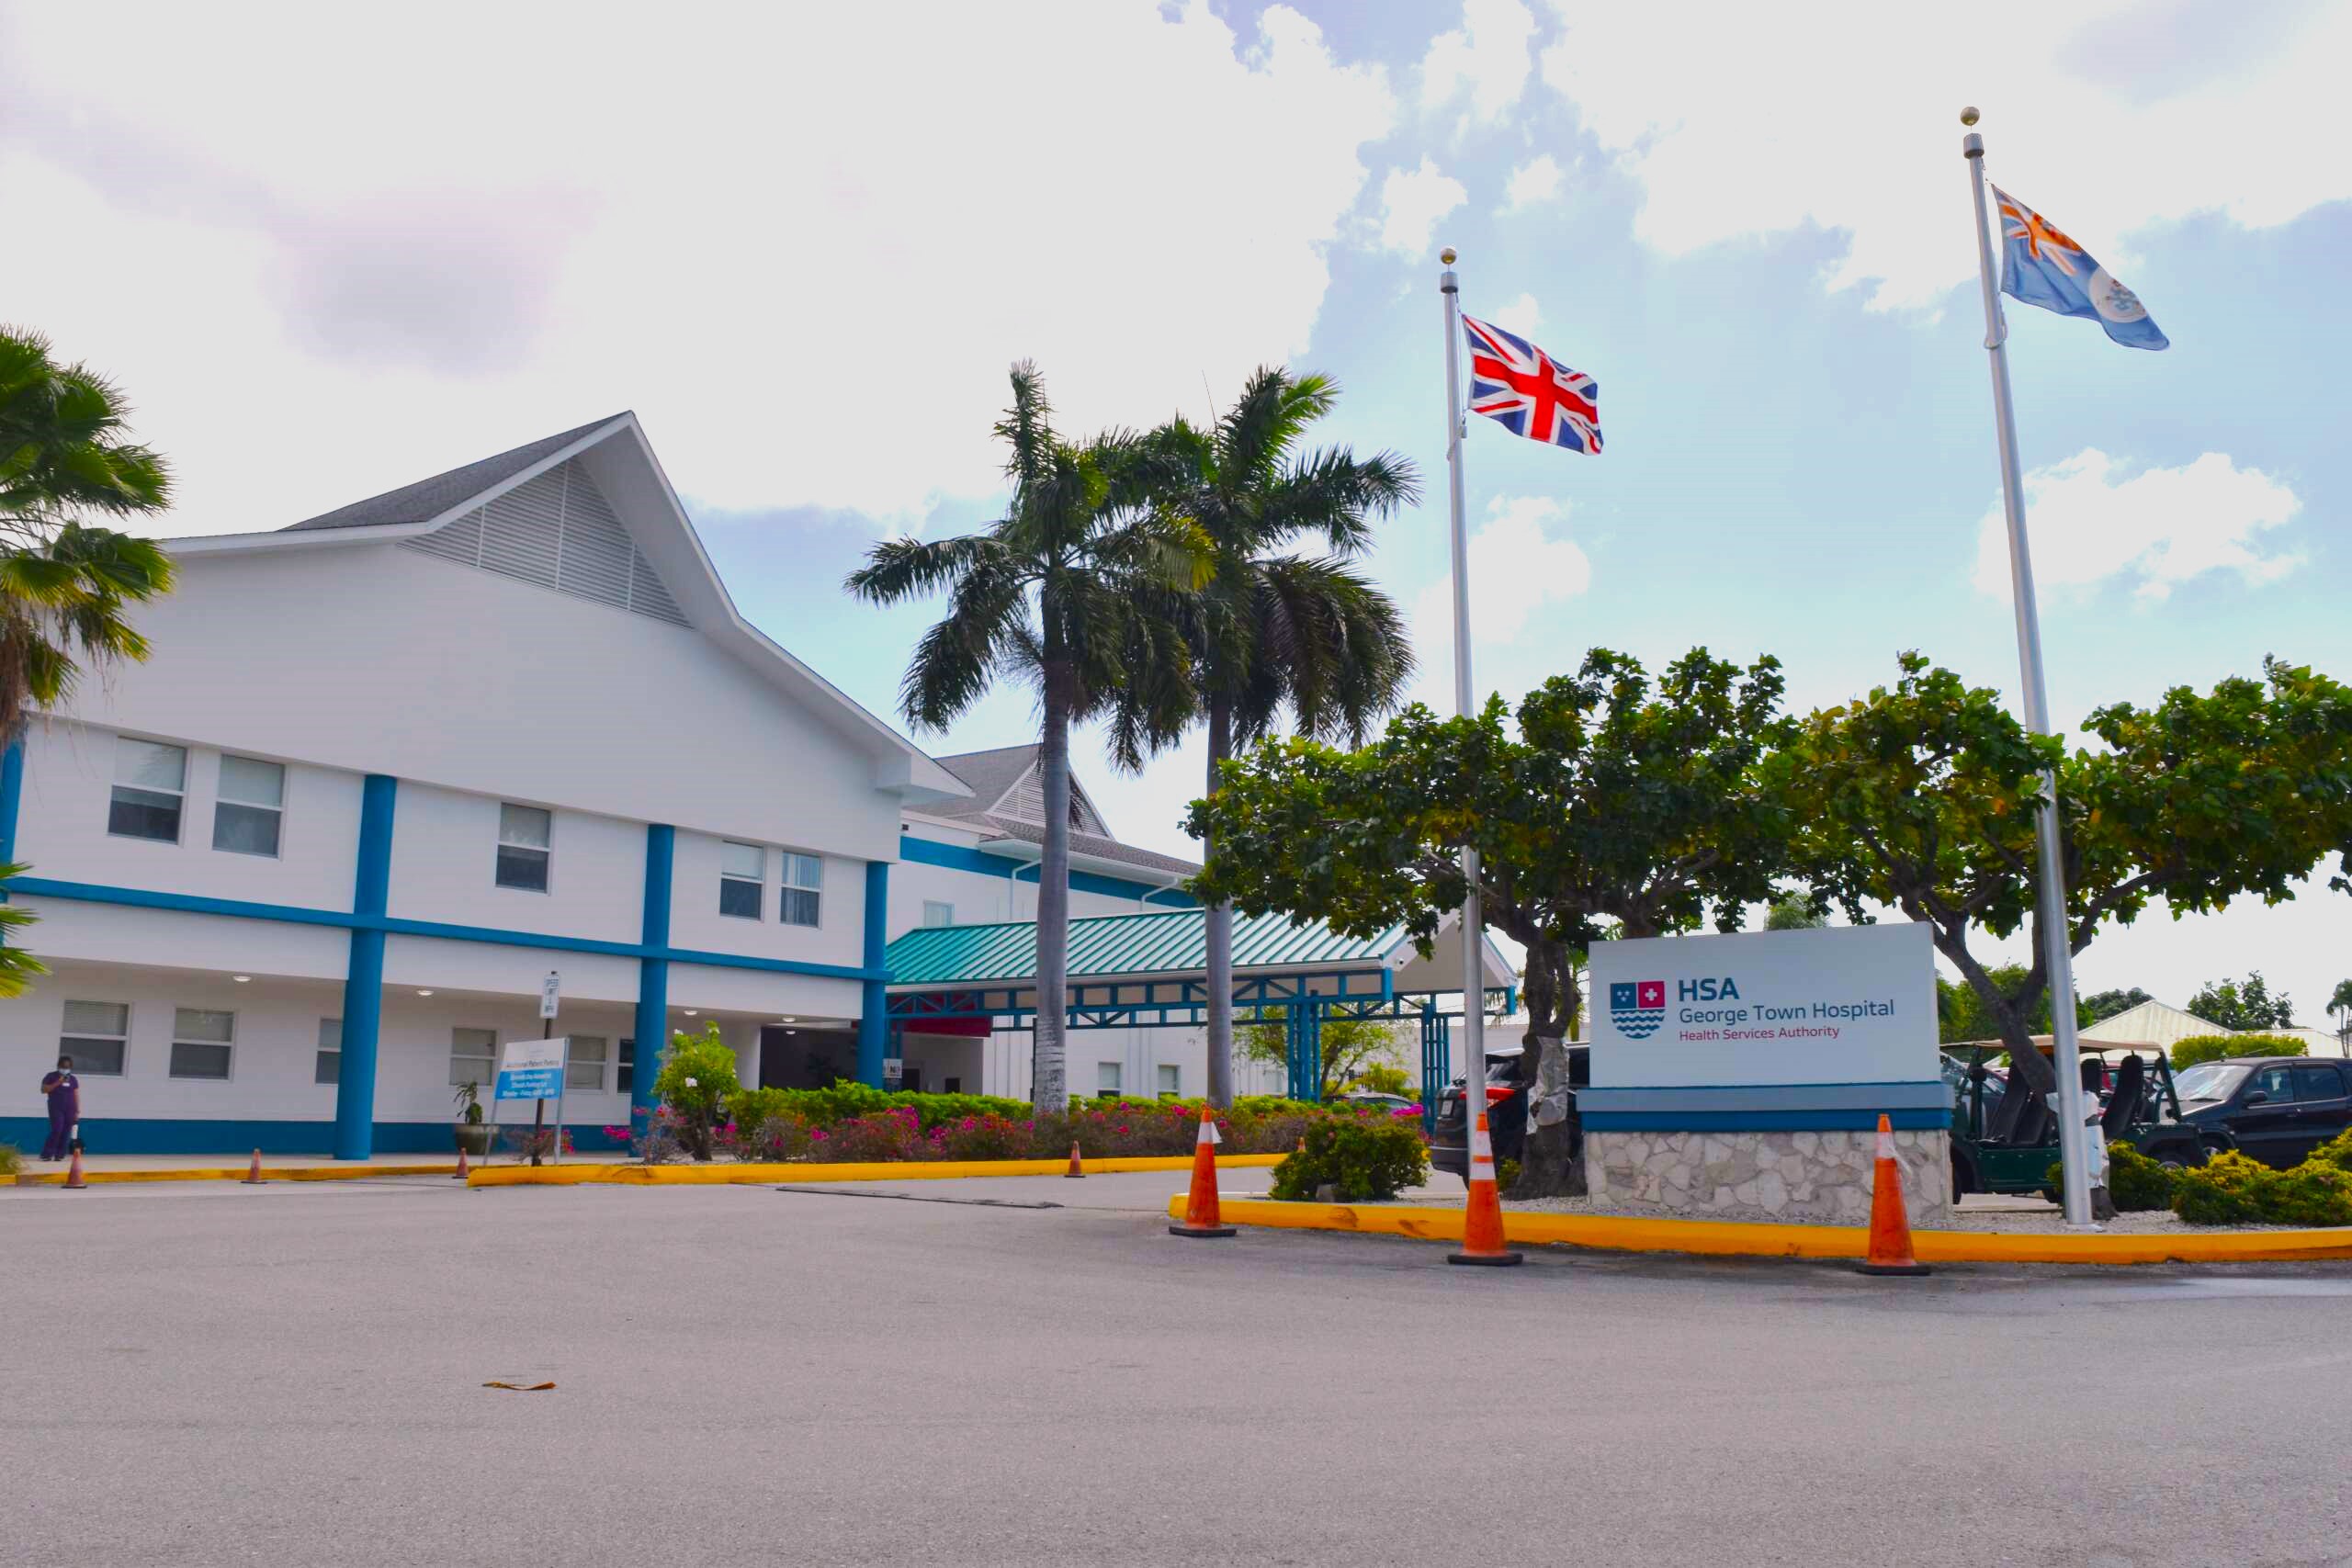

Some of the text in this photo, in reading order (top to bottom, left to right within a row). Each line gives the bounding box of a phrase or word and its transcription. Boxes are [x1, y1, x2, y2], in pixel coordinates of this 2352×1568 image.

[1679, 977, 1740, 1001] HSA
[1679, 998, 1894, 1025] George Town Hospital
[1679, 1025, 1840, 1041] Health Services Authority
